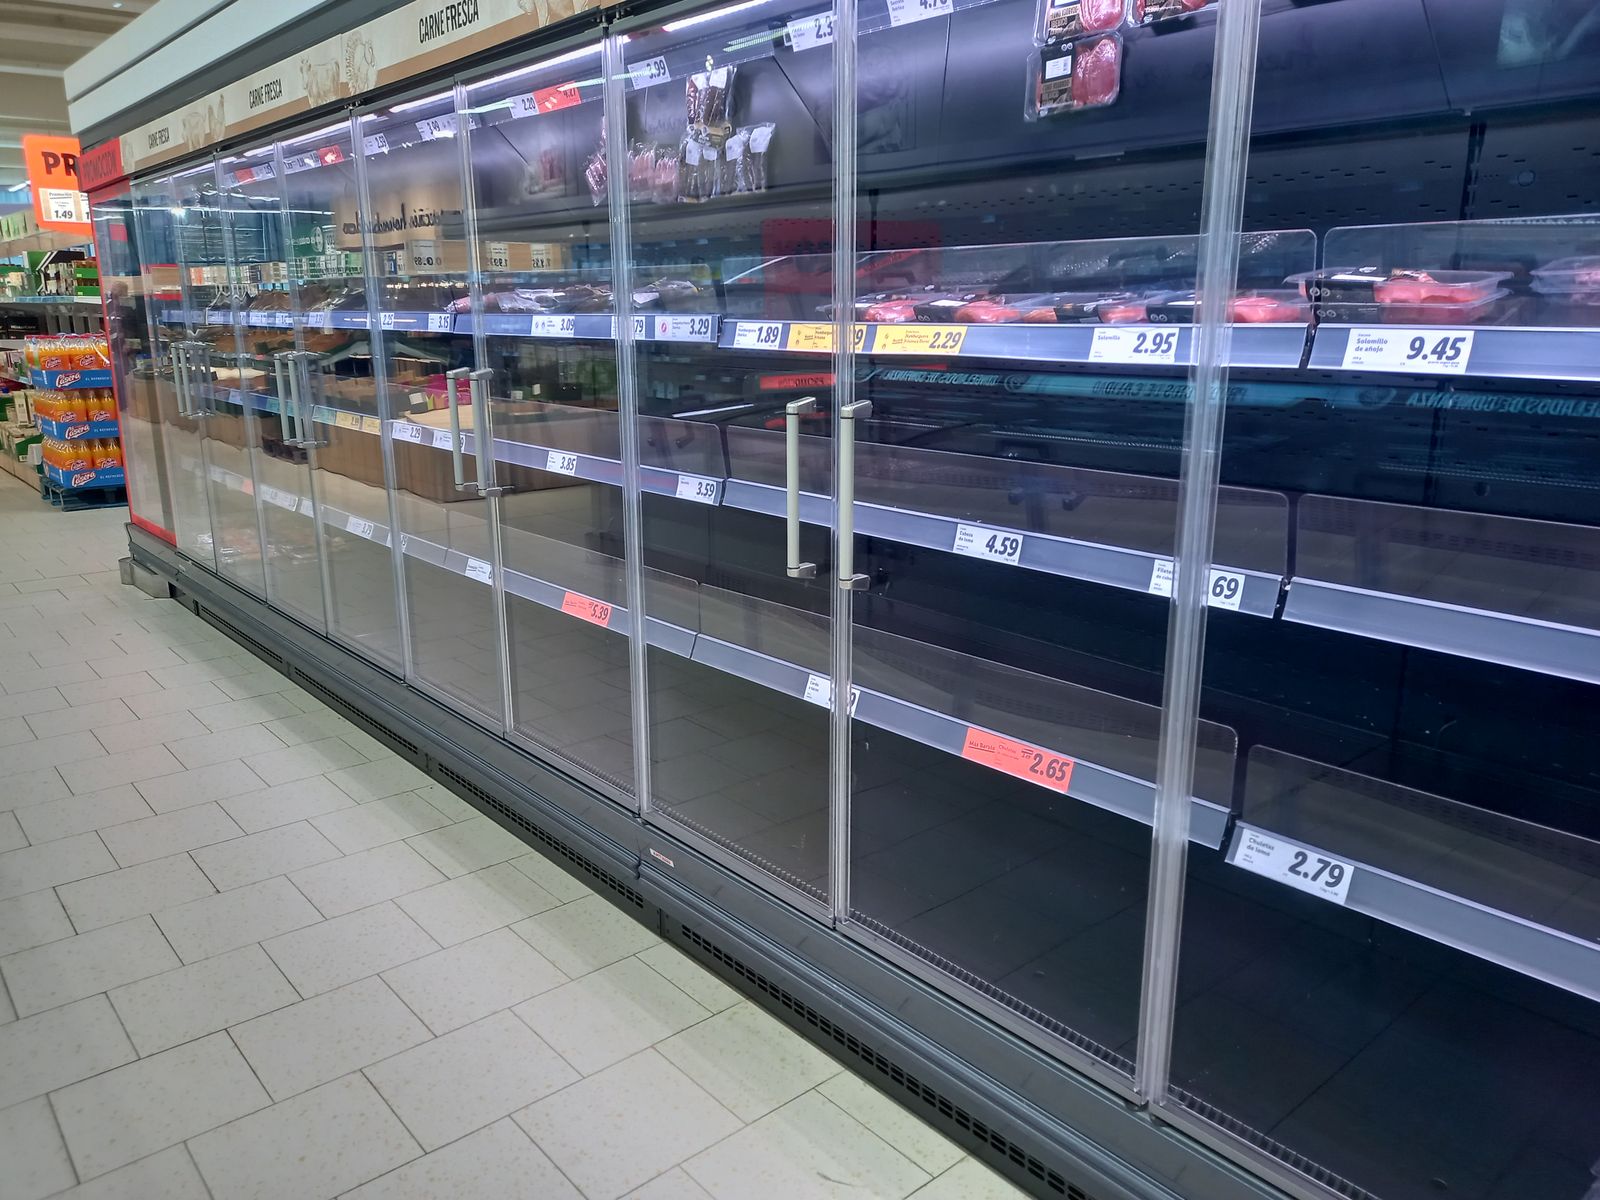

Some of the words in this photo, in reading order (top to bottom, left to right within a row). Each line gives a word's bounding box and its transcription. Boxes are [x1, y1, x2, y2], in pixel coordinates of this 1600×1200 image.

[419, 13, 445, 44] CARNE
[446, 0, 480, 32] FRESCA
[814, 16, 833, 40] 2.3
[249, 86, 264, 109] CARNE
[264, 78, 283, 102] FRESCA
[148, 134, 158, 150] CARNE
[158, 127, 170, 145] FRESCA
[54, 210, 73, 219] 1.49
[560, 318, 574, 332] 3.09
[689, 318, 710, 335] 3.29
[757, 326, 779, 344] 1.89
[929, 331, 962, 349] 2.29
[1132, 332, 1176, 354] 2.95
[1356, 337, 1388, 345] Solomillo
[1406, 336, 1466, 361] 9.45
[56, 372, 80, 388] Casera
[65, 424, 90, 440] Casera
[559, 456, 576, 471] 3.85
[72, 471, 96, 487] Casera
[696, 481, 715, 497] 3.59
[985, 534, 1020, 557] 4.59
[1211, 575, 1240, 600] 69
[591, 605, 609, 621] 5.39
[1029, 753, 1070, 782] 2.65
[1246, 844, 1254, 852] de
[1248, 837, 1275, 851] Chuletas
[1287, 850, 1345, 888] 2.79
